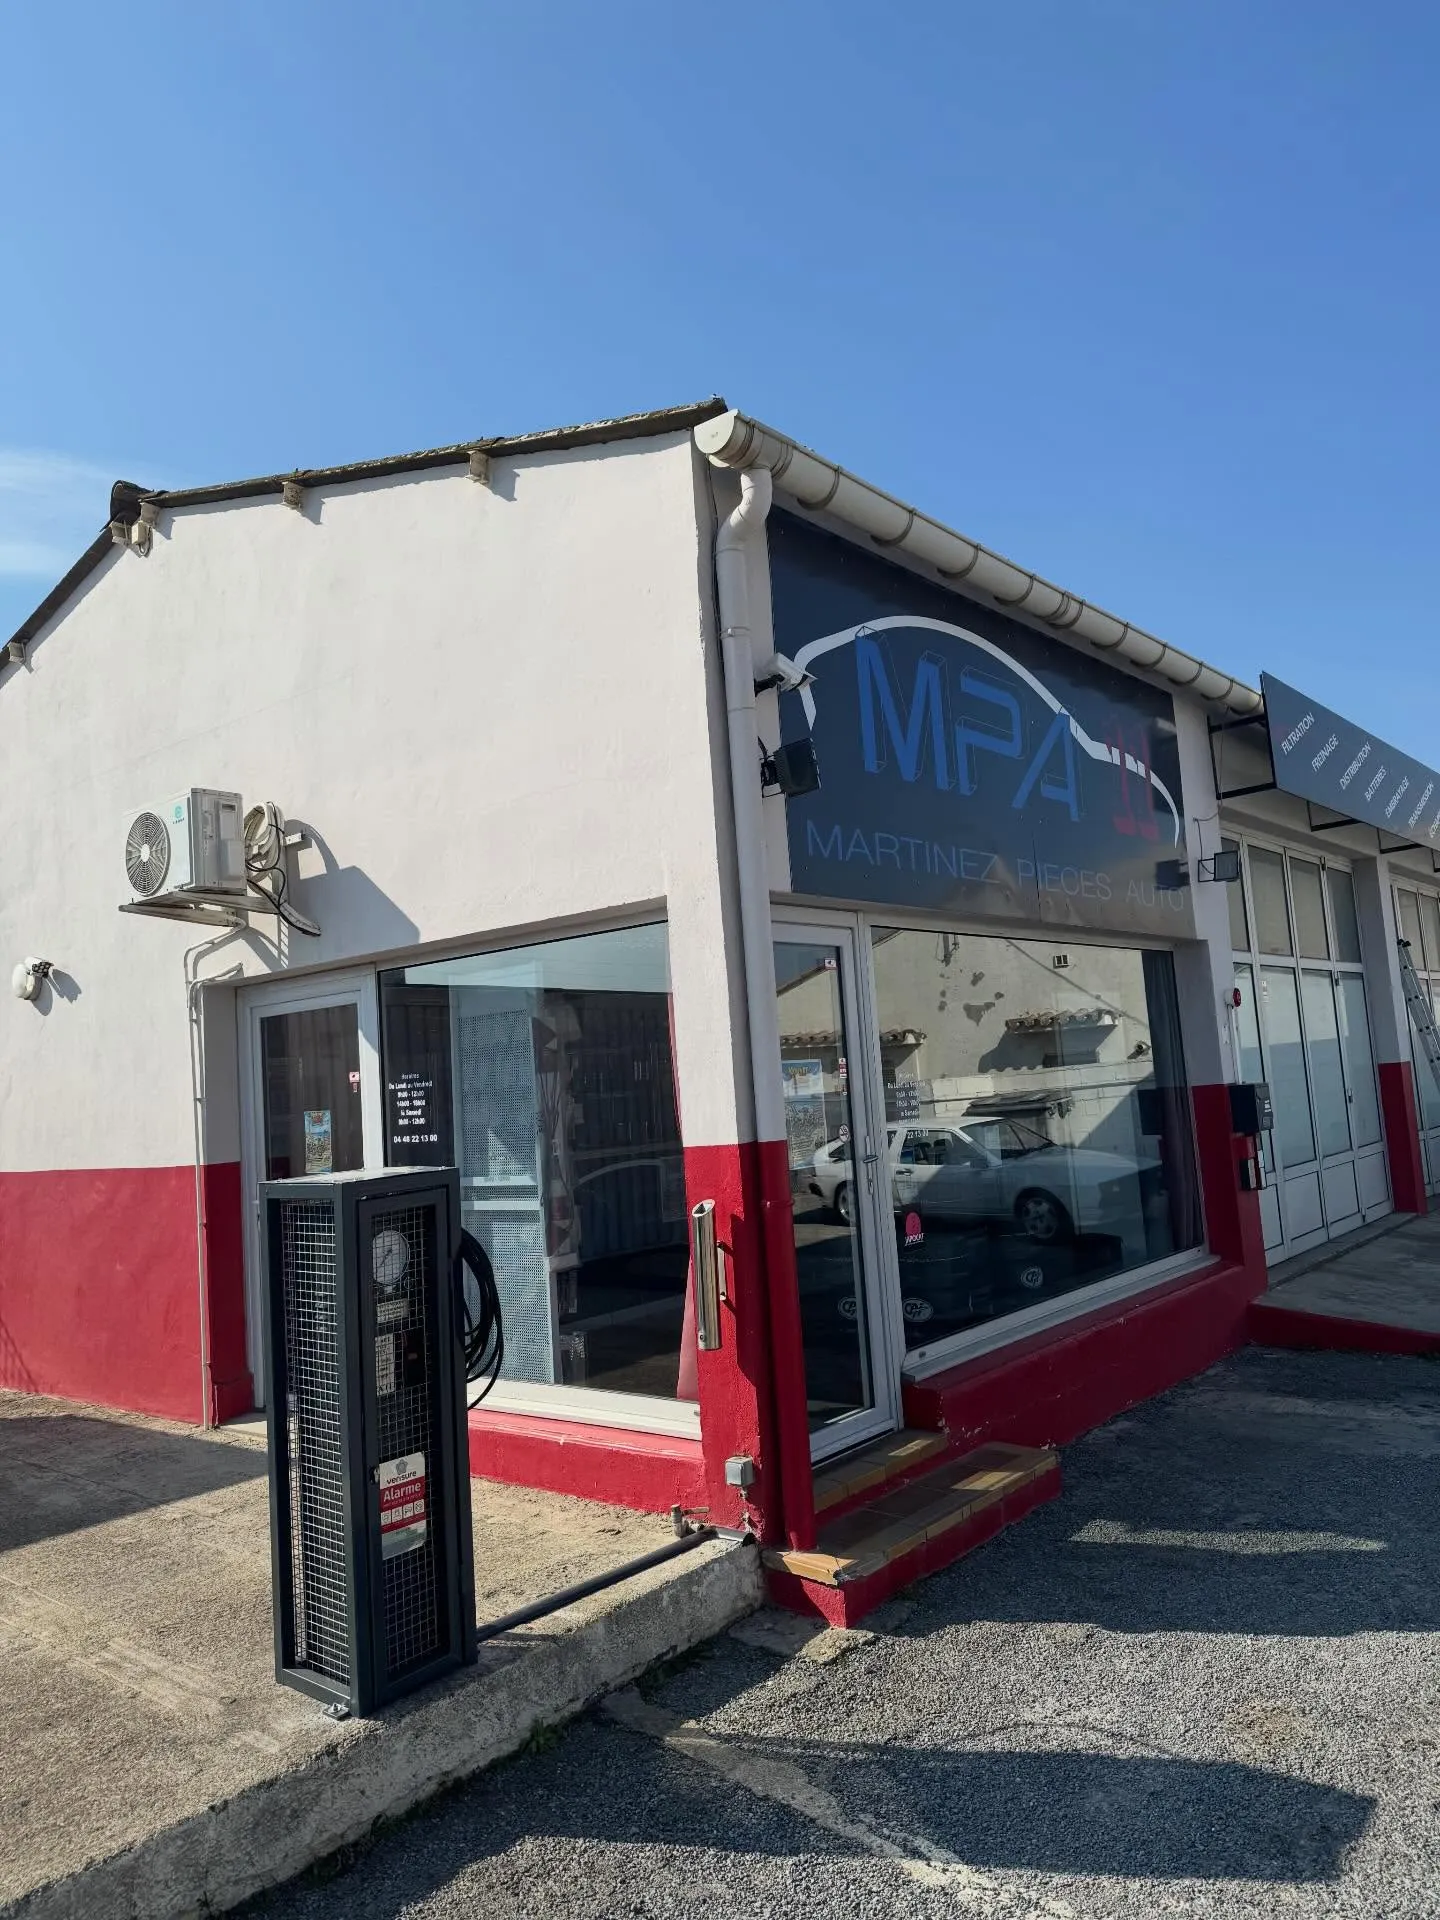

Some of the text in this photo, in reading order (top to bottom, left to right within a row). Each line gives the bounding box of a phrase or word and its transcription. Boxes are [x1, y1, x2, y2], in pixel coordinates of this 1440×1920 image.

[854, 628, 1084, 822] MPA
[1281, 712, 1315, 755] FILTRATION
[1311, 734, 1340, 772] FREINAGE
[1339, 742, 1372, 790] DISTRIBUTION
[806, 820, 1185, 911] MARTINEZ PIECES AUTO
[429, 1134, 438, 1142] 00
[383, 1482, 422, 1502] Alarme
